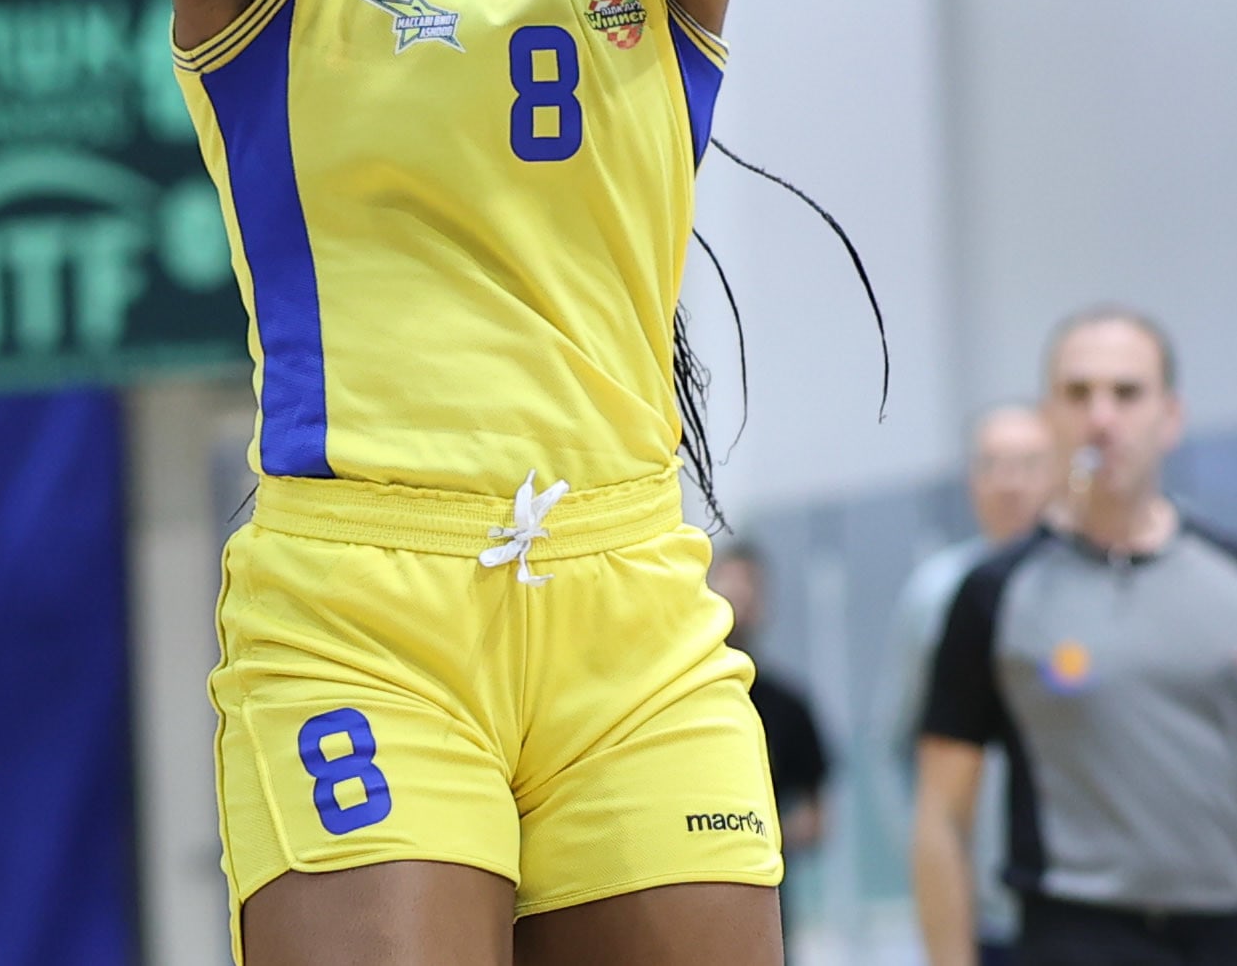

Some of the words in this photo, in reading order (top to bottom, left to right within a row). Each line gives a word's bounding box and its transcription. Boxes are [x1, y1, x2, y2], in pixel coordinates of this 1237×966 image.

[586, 10, 647, 30] Winner
[509, 25, 583, 162] 8
[298, 707, 391, 836] 8
[685, 811, 767, 838] macron
